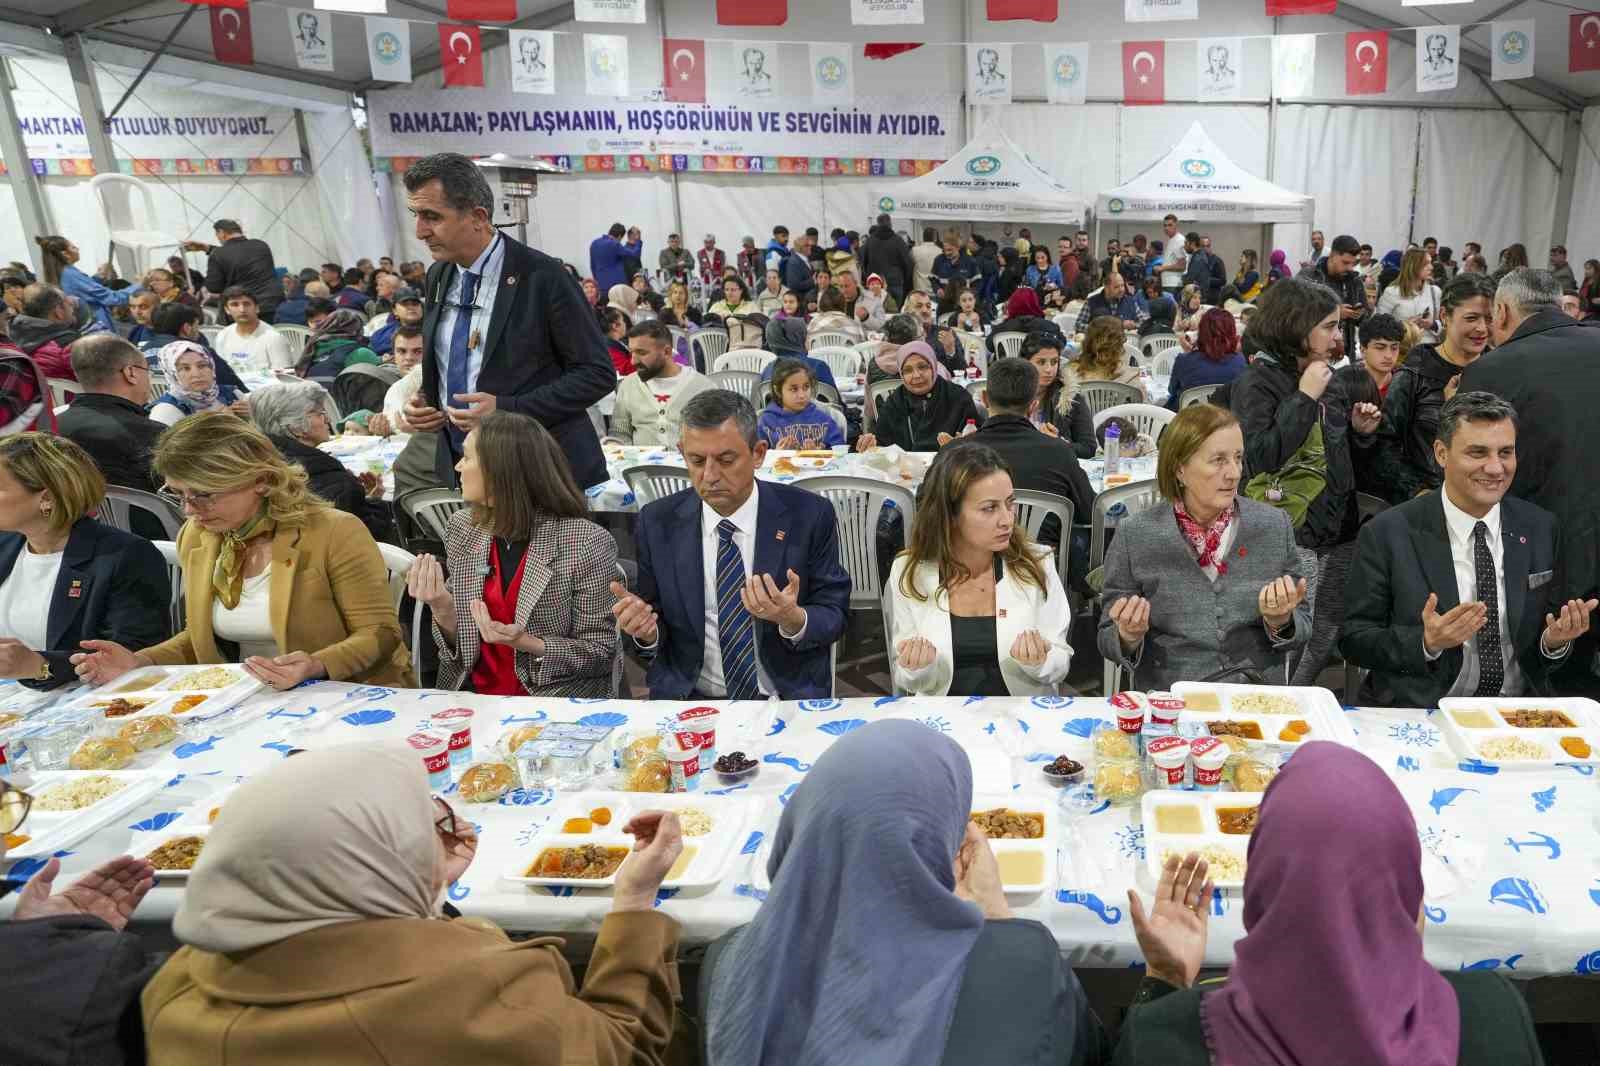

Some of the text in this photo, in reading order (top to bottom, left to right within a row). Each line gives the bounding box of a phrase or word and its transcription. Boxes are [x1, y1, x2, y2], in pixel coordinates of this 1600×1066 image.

[175, 117, 275, 135] DUYUYORUZ.
[389, 104, 946, 137] RAMAZAN; PAYLAŞMANIN, HOŞGÖRÜNÜN VE SEVGİNİN AYIDIR.
